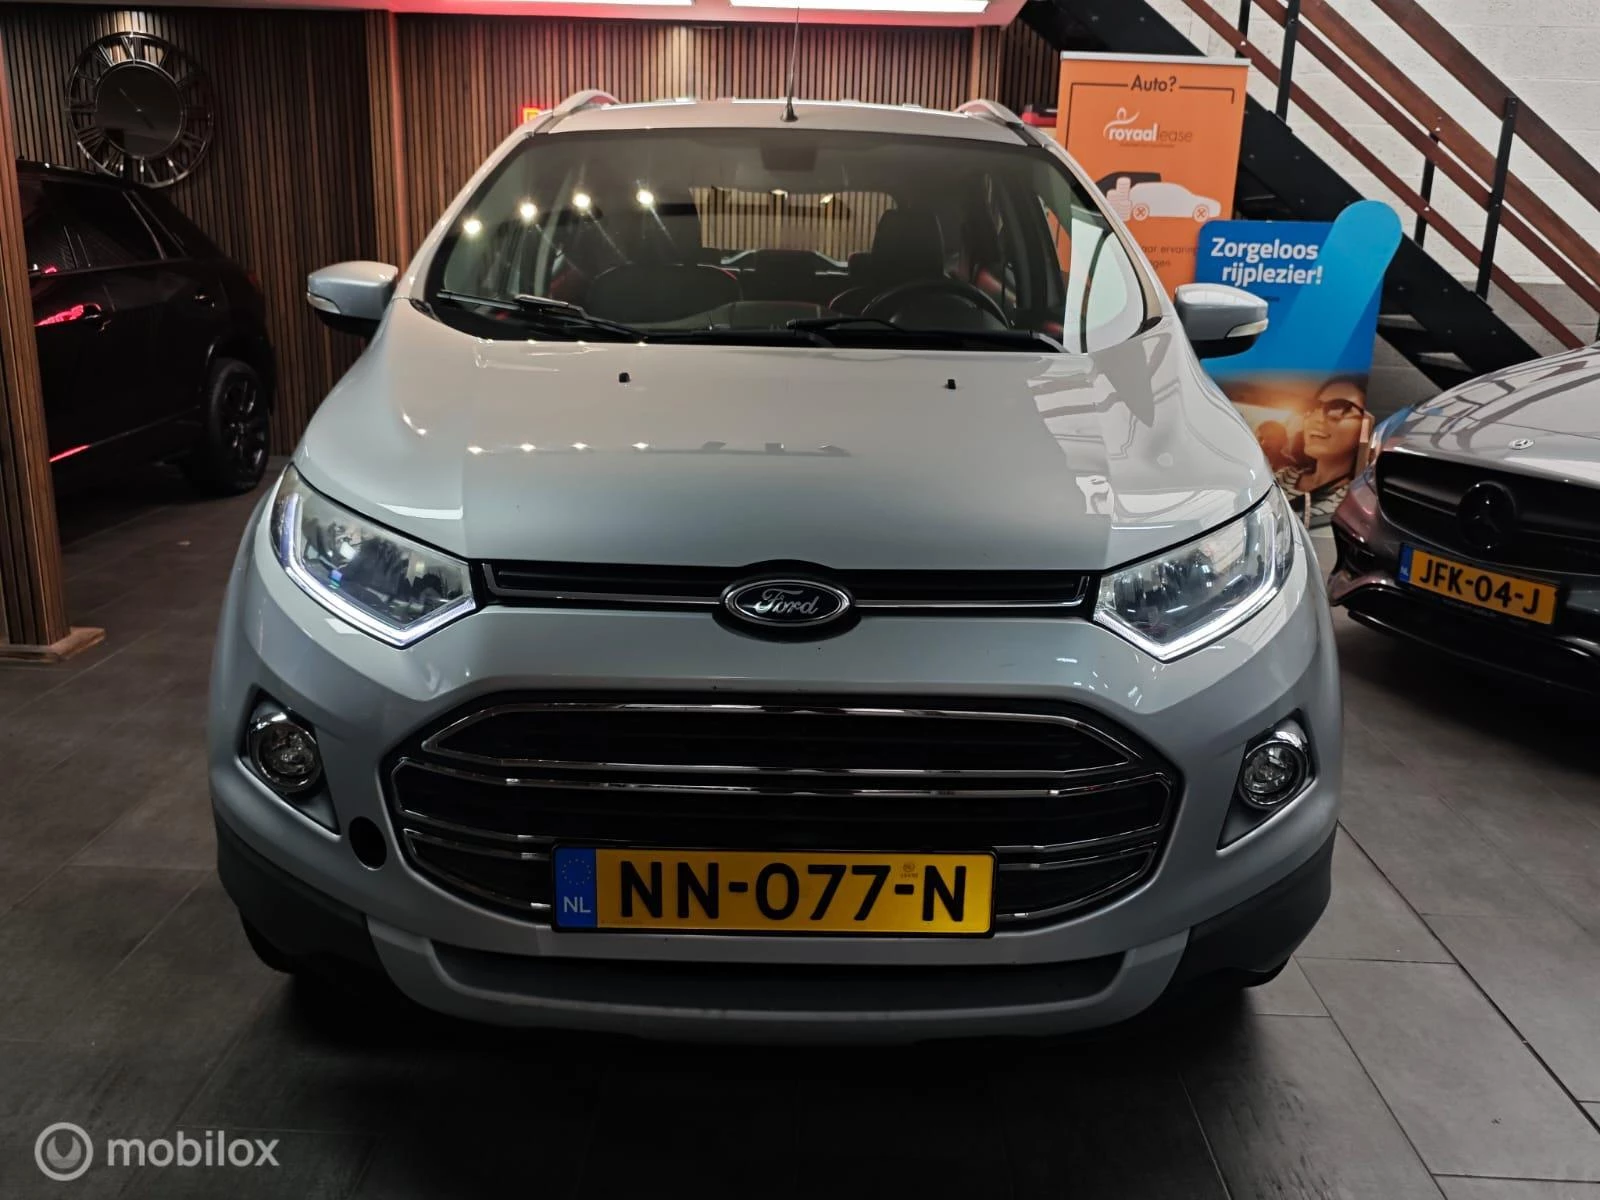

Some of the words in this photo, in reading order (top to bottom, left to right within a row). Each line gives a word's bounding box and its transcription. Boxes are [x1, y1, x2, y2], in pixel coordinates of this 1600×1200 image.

[1131, 73, 1177, 93] Auto?
[1211, 237, 1319, 264] Zorgeloos
[1222, 263, 1324, 288] rijplezier!
[1419, 559, 1540, 615] JFK-04-J
[752, 587, 820, 615] Ford
[562, 895, 592, 914] NL
[620, 861, 968, 923] NN-077-N
